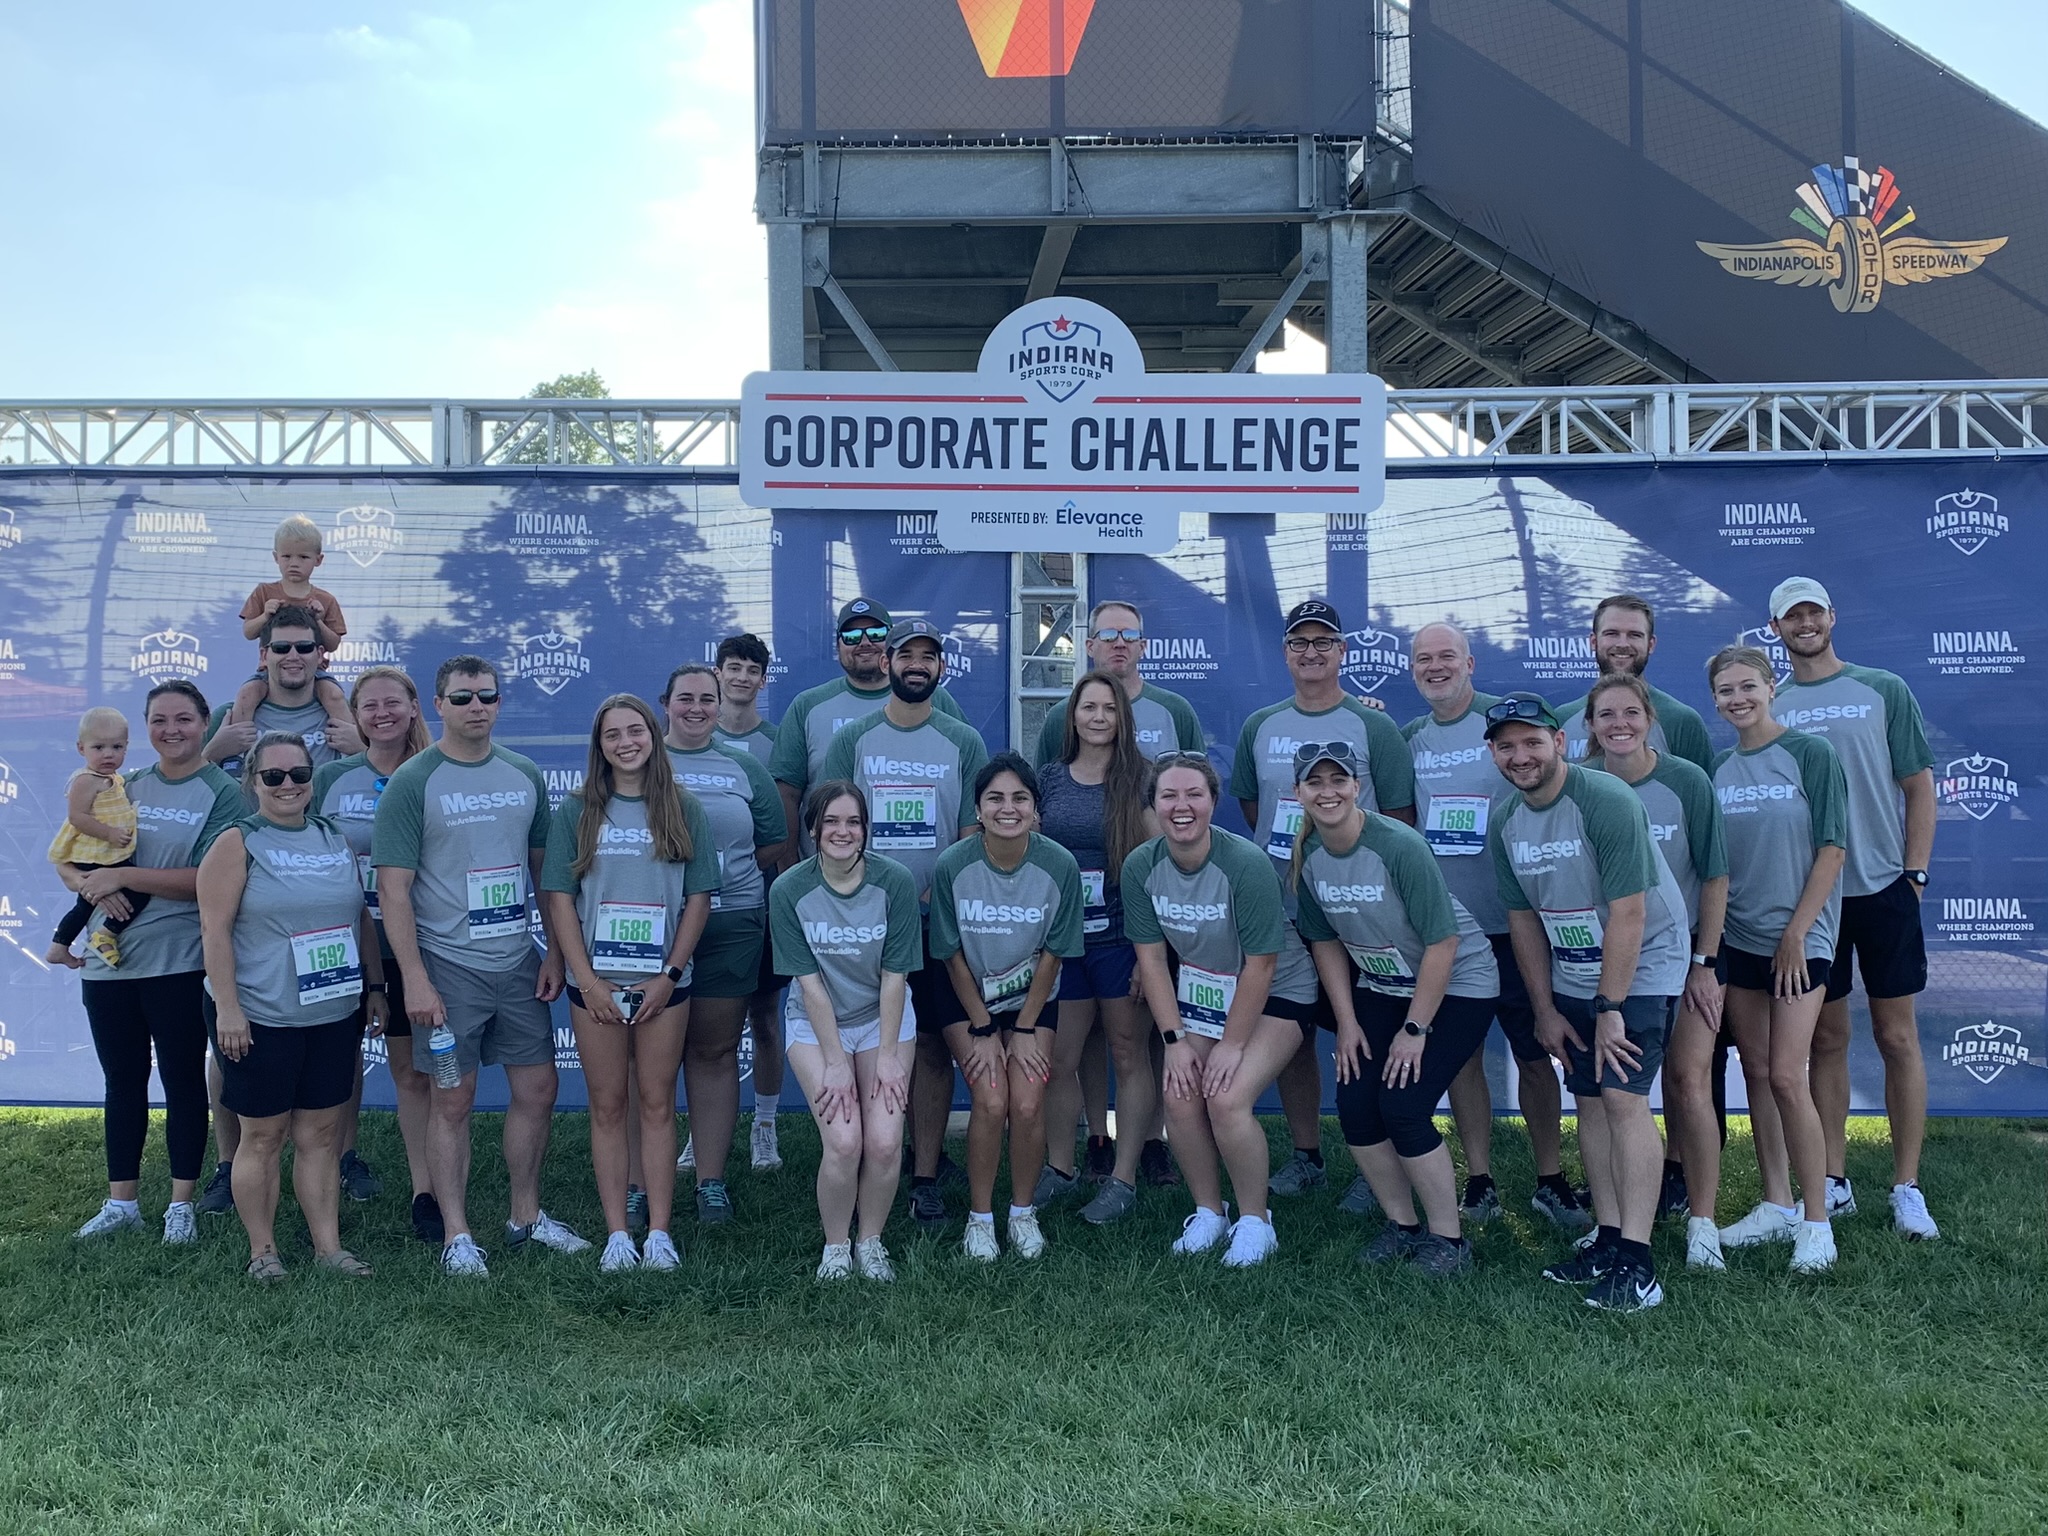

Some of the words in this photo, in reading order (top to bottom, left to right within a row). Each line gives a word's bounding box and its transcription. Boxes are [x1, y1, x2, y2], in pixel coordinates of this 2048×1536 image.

[1733, 255, 1835, 272] INDIANAPOLIS
[1892, 254, 1969, 270] SPEEDWAY
[1856, 227, 1880, 304] MOTOR
[1009, 345, 1113, 374] INDIANA
[1020, 365, 1067, 381] SPORTS
[1071, 365, 1102, 381] CORP
[764, 414, 1048, 470] CORPORATE
[1070, 416, 1361, 473] CHALLENGE
[135, 512, 212, 533] INDIANA.
[515, 514, 593, 535] INDIANA.
[971, 511, 1030, 525] PRESENTED
[1032, 512, 1049, 525] BY:
[1056, 507, 1144, 525] Elevance
[1724, 503, 1808, 525] INDIANA.
[1926, 510, 2010, 534] INDIANA
[128, 536, 162, 544] WHERE
[164, 536, 218, 544] CHAMPIONS
[326, 525, 404, 546] INDIANA
[509, 537, 542, 545] WHERE
[544, 538, 600, 546] CHAMPIONS
[890, 538, 923, 546] WHERE
[1098, 526, 1144, 538] Health
[1718, 528, 1754, 536] WHERE
[1756, 527, 1816, 536] CHAMPIONS
[1730, 538, 1750, 546] ARE
[1935, 526, 1973, 539] SPORTS
[1975, 526, 2001, 538] CORP
[139, 545, 158, 553] ARE
[334, 539, 371, 551] SPORTS
[519, 547, 538, 555] ARE
[900, 547, 919, 555] ARE
[1330, 543, 1350, 551] ARE
[324, 641, 400, 662] NDIANA.
[1141, 638, 1212, 660] NDIANA.
[1528, 637, 1596, 659] INDIAN
[1933, 630, 2019, 654] INDIANA.
[130, 650, 208, 672] INDIANA
[138, 664, 174, 677] SPORTS
[175, 665, 200, 677] CORP
[326, 665, 350, 673] HERE
[513, 652, 591, 674] INDIANA
[1136, 662, 1161, 671] HERE
[1162, 663, 1219, 671] CHAMPIONS
[1375, 664, 1401, 677] CORP
[1522, 661, 1557, 670] WHERE
[1927, 656, 1964, 665] WHERE
[1966, 655, 2026, 664] CHAMPIONS
[521, 667, 556, 679] SPORTS
[558, 667, 582, 679] CORP
[1534, 671, 1554, 679] ARE
[1555, 671, 1600, 679] CROWNE
[1940, 667, 1961, 675] ARE
[1775, 703, 1872, 729] Messer
[863, 755, 950, 779] Messer
[1413, 745, 1487, 770] Messer
[673, 773, 737, 789] esser
[1936, 775, 2020, 799] INDIANA
[439, 790, 528, 816] Messer
[1716, 783, 1798, 806] Messer
[1945, 791, 1983, 804] SPORTS
[1984, 791, 2012, 803] CORP
[884, 800, 925, 822] 1626
[1439, 809, 1476, 830] 1589
[264, 847, 351, 869] Messer
[1511, 838, 1582, 864] Messer
[481, 881, 517, 908] 1621
[1314, 880, 1385, 902] Messer
[959, 898, 1049, 924] Messer
[1151, 894, 1228, 921] Messer
[1943, 897, 2028, 920] INDIANA.
[609, 918, 652, 943] 1588
[803, 921, 887, 944] Messe
[1553, 925, 1595, 947] 1605
[1936, 923, 1973, 931] WHERE
[1975, 923, 2035, 931] CHAMPIONS
[1948, 933, 1969, 941] ARE
[306, 942, 349, 972] 1592
[1360, 955, 1401, 975] 1604
[1188, 981, 1225, 1010] 1603
[363, 1052, 387, 1065] CORP
[1942, 1040, 2030, 1061] INDIANA
[1952, 1053, 1990, 1067] SPORTS
[1992, 1055, 2019, 1067] CORP
